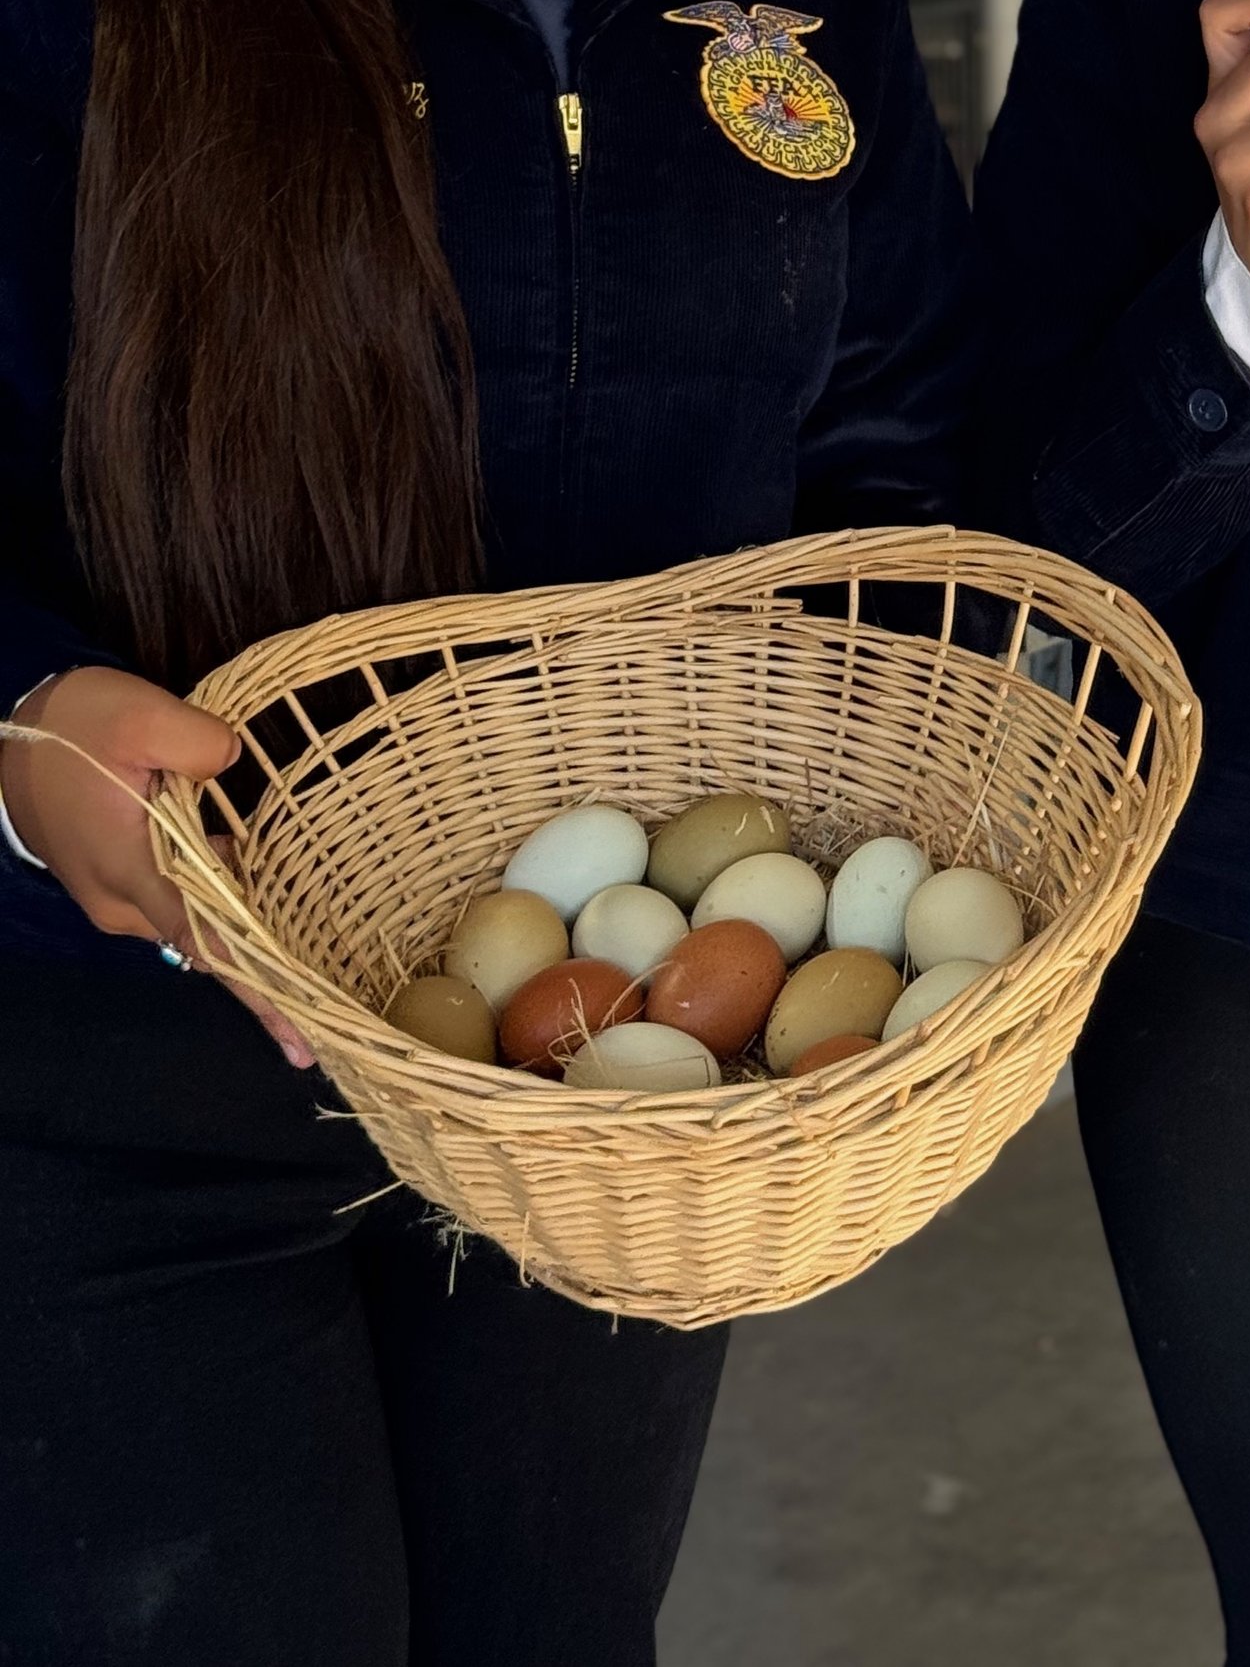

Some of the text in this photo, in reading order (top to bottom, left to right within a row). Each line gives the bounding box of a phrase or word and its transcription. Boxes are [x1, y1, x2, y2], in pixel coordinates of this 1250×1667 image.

[728, 61, 822, 102] AGRICULTURAL
[749, 75, 802, 97] FFA
[751, 126, 831, 155] EDUCATION
